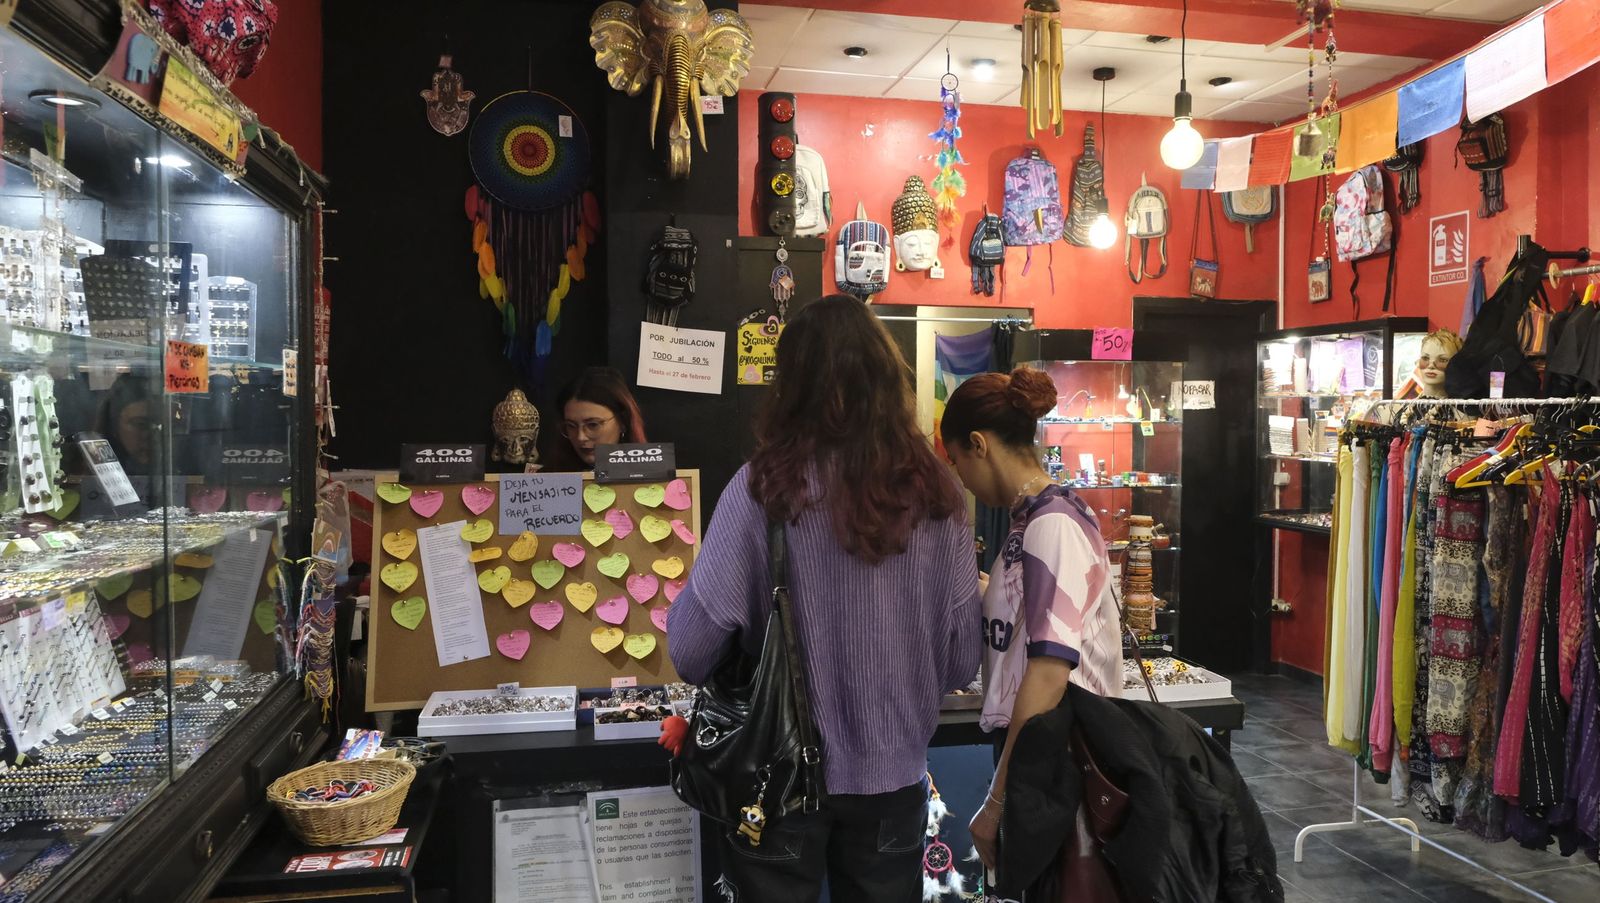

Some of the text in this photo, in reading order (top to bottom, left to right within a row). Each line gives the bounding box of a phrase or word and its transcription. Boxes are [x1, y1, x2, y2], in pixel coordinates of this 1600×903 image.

[1432, 272, 1456, 282] EXTINTOR
[650, 333, 715, 348] POR JUBILACIÓN
[653, 351, 672, 361] TODO
[648, 367, 665, 376] Hasta
[689, 373, 711, 381] febrero
[416, 448, 473, 456] 400
[609, 448, 662, 457] 400
[608, 455, 663, 463] GALLINAS
[504, 479, 528, 490] DEJA
[510, 486, 576, 504] MENSAJITO
[505, 504, 544, 518] PARA EL
[524, 513, 580, 531] RECUERDO
[640, 805, 692, 817] establecimiento
[619, 822, 638, 831] hojas
[660, 817, 682, 826] quejas
[688, 817, 693, 825] y
[596, 832, 645, 843] reclamaciones
[619, 843, 648, 853] personas
[650, 838, 693, 849] consumidoras
[605, 855, 633, 864] usuarias
[624, 877, 671, 889] establishment
[621, 892, 634, 900] and
[638, 887, 671, 898] complaint
